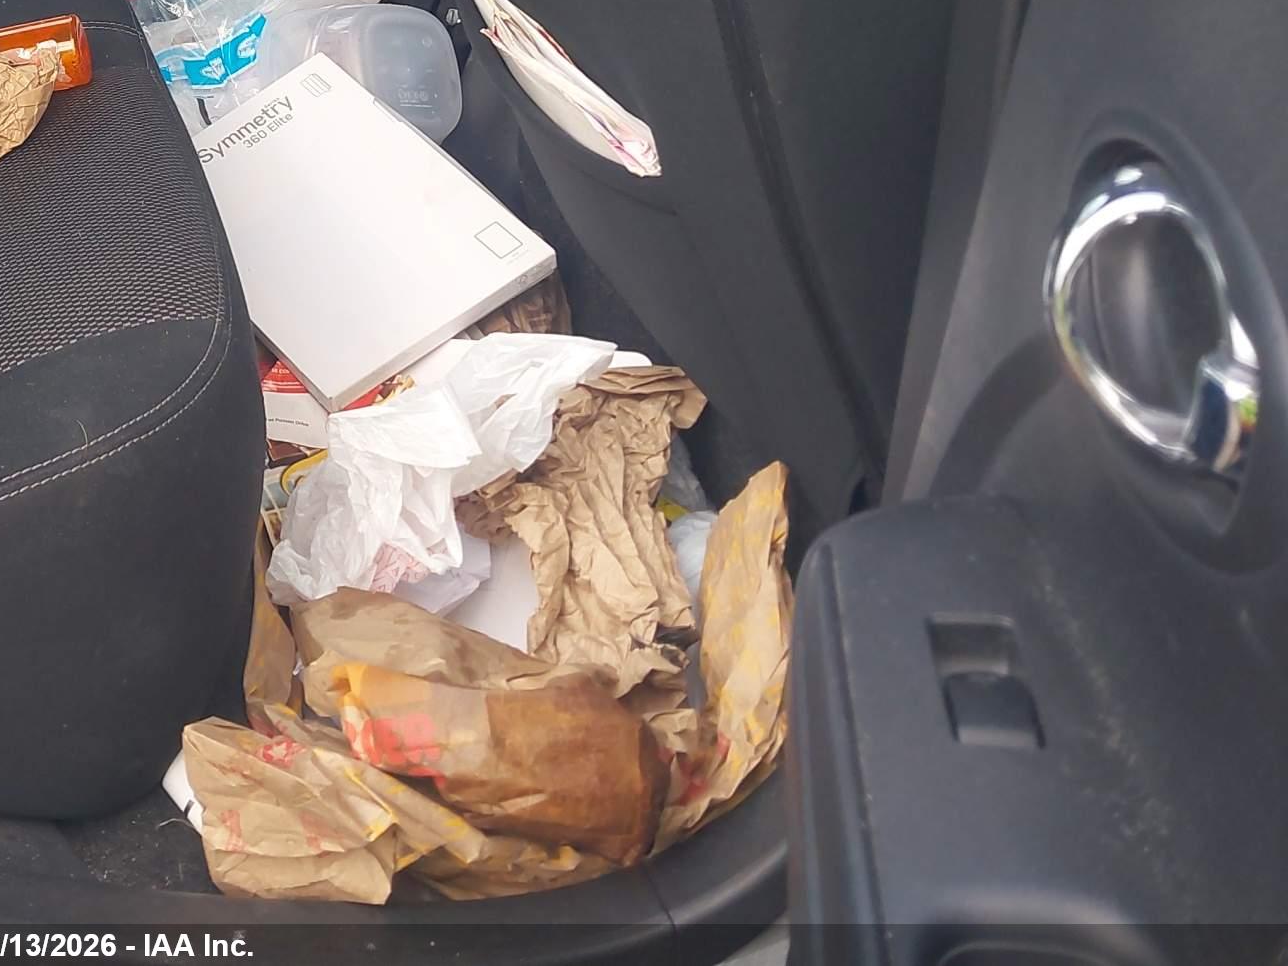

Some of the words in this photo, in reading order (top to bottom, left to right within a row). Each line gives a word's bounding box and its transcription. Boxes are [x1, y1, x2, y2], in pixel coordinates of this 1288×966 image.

[198, 96, 293, 164] Symmetry
[243, 129, 268, 149] 360
[267, 113, 294, 132] Elite
